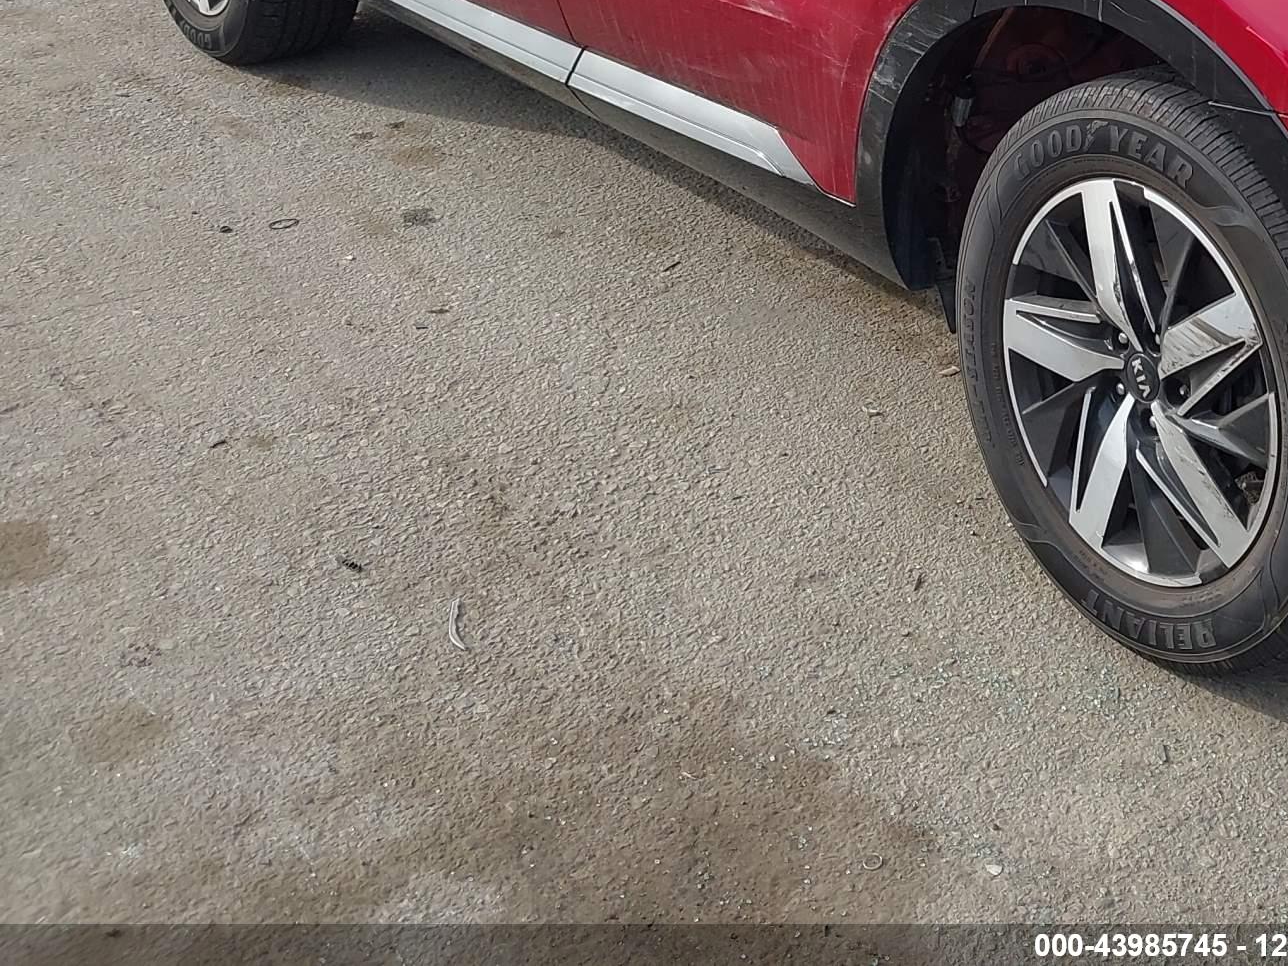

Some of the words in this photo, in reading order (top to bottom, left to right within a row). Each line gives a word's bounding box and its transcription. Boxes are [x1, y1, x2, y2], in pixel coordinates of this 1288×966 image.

[1108, 125, 1193, 189] YEAR
[1131, 357, 1151, 399] KIA
[1081, 589, 1216, 650] RELIANT
